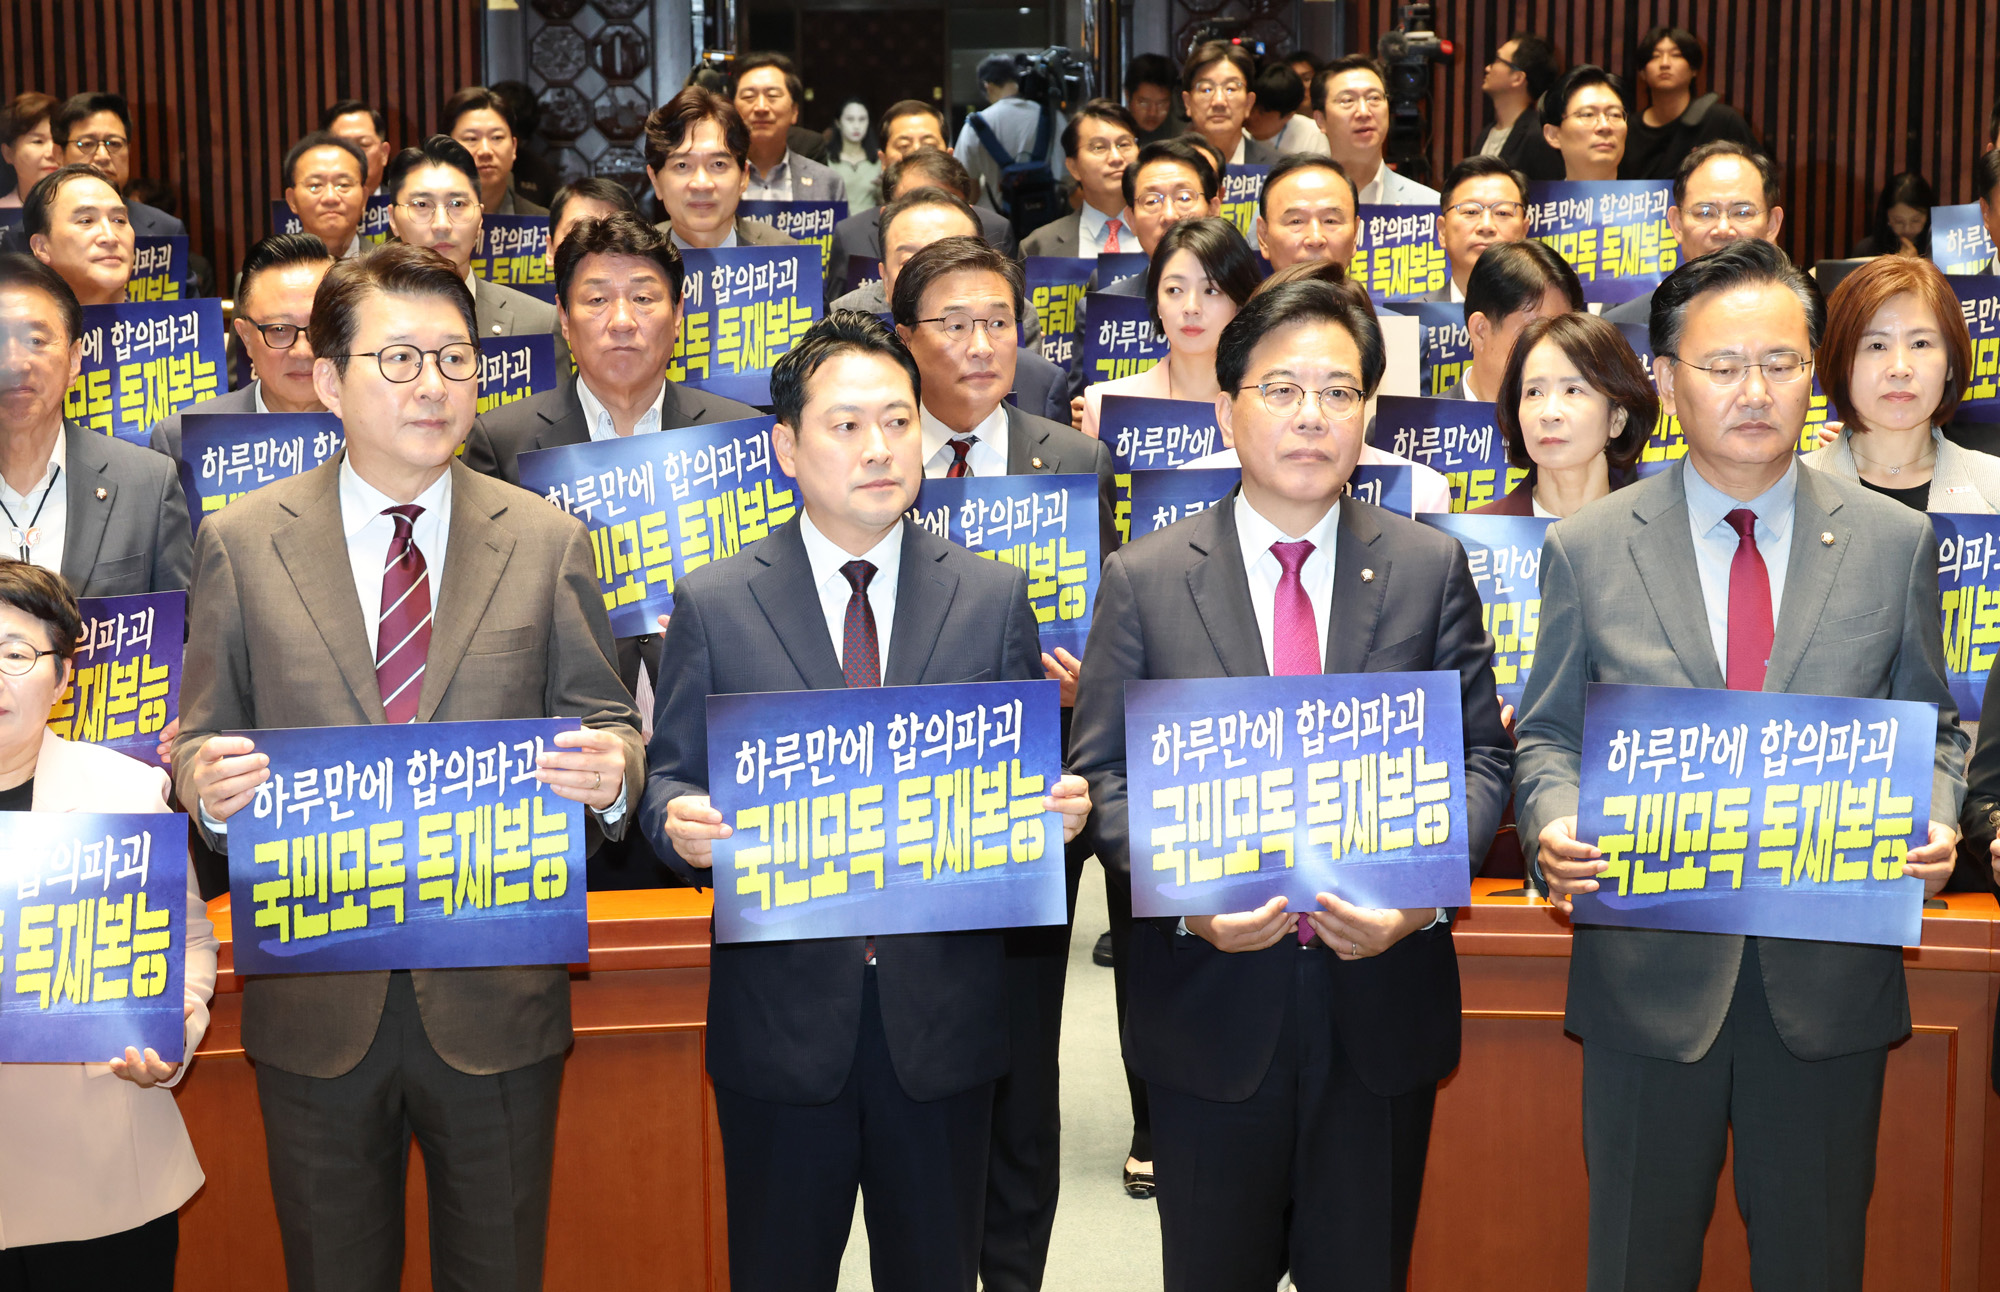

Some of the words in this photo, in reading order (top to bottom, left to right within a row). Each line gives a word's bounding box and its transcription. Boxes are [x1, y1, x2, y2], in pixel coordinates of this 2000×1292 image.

[1370, 212, 1435, 246] 합의파괴
[1526, 197, 1594, 232] 하루만에
[1600, 188, 1668, 226] 합의파괴
[1373, 241, 1446, 297] 독재본능
[1602, 219, 1679, 278] 독재본능
[712, 257, 798, 305] 합의파괴
[111, 311, 199, 362] 합의파괴
[1961, 296, 2000, 333] 루만
[202, 436, 303, 487] 하루만에
[663, 431, 770, 501] 합의파괴
[1116, 424, 1215, 466] 하루만에
[1394, 424, 1493, 466] 하루만에
[960, 488, 1068, 547] 합의파괴
[590, 511, 674, 611] 민모독
[974, 537, 1087, 622] 본능
[1938, 532, 2000, 582] 의파
[735, 720, 875, 795] 하루만에
[888, 699, 1023, 773] 합의파괴
[1151, 707, 1283, 775] 하루만에
[1296, 688, 1425, 758] 합의파괴
[1607, 721, 1748, 784] 하루만에
[1760, 717, 1898, 778] 합의파괴
[254, 756, 393, 829] 하루만에
[406, 736, 545, 810] 합의파괴
[734, 784, 885, 911] 국민모독
[897, 758, 1046, 880] 독재본능
[1151, 767, 1296, 887] 국민모독
[1306, 745, 1451, 860] 독재본능
[1596, 786, 1751, 897] 국민모독
[1758, 777, 1914, 886] 독재본능
[253, 819, 406, 943] 국민모독
[417, 796, 569, 916] 독재본능
[16, 892, 170, 1010] 독재본능
